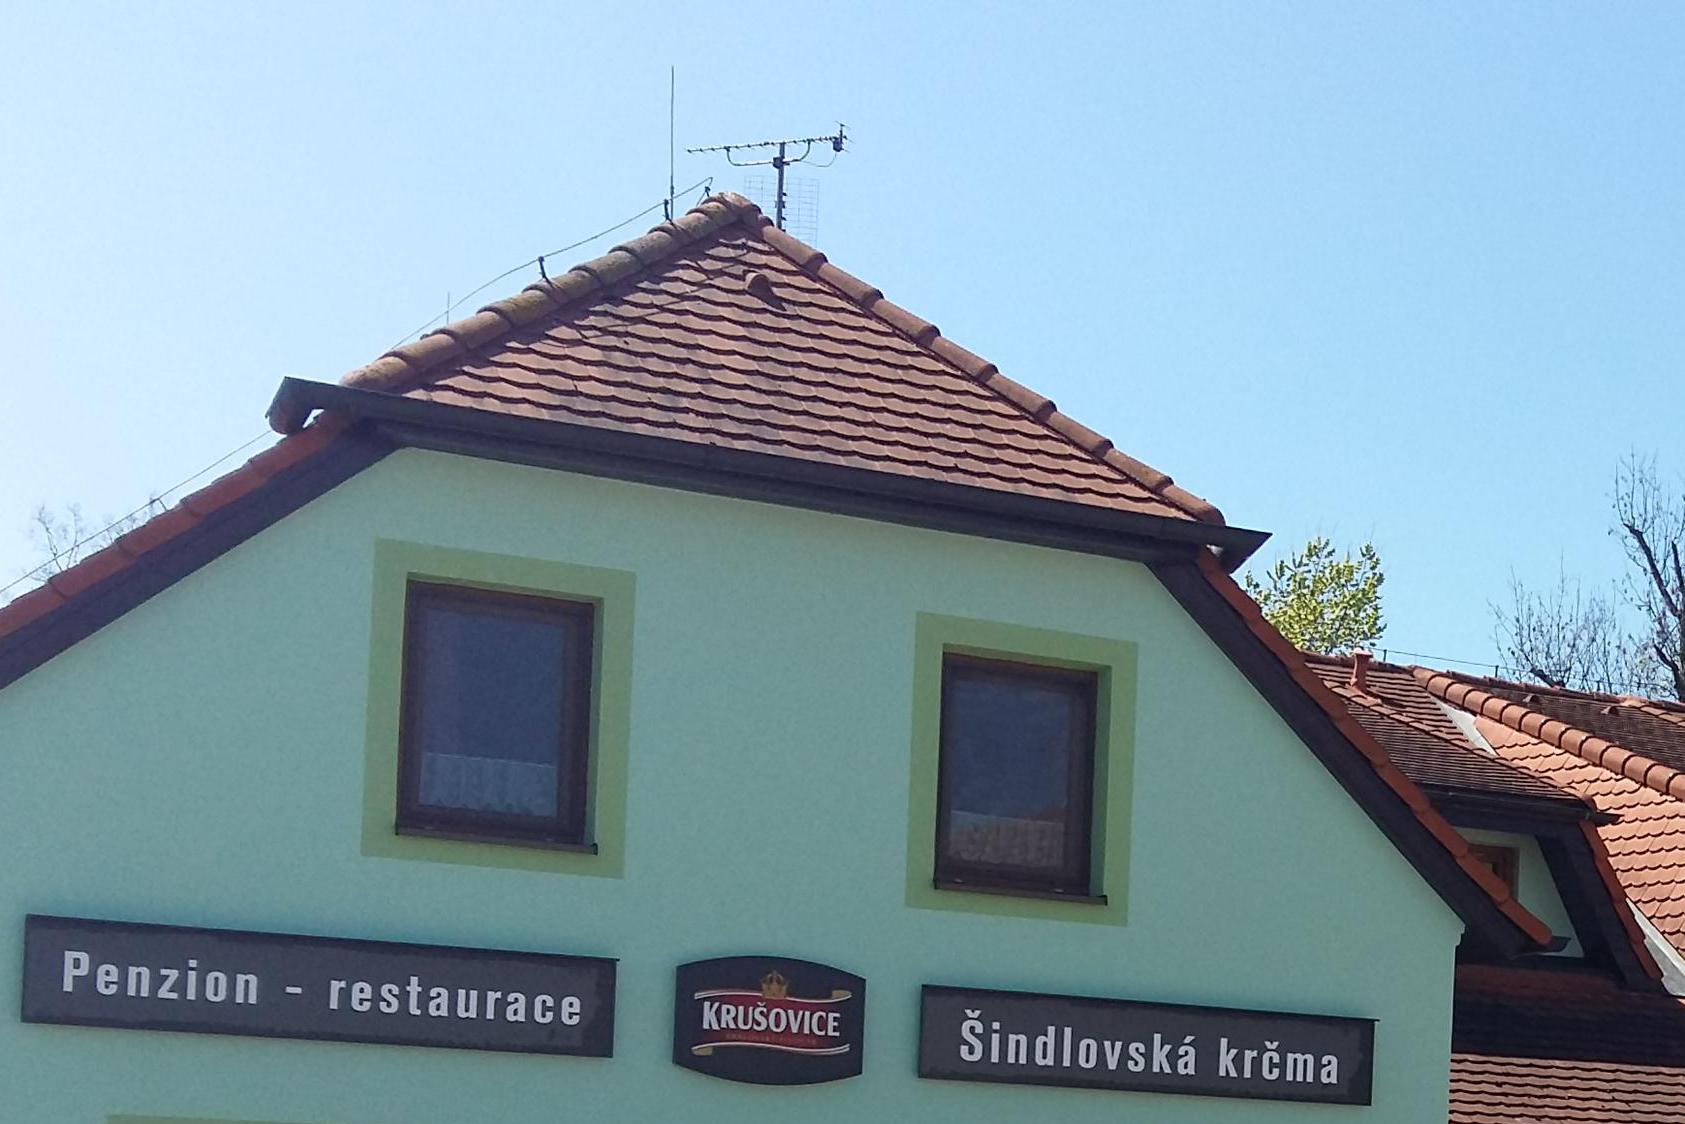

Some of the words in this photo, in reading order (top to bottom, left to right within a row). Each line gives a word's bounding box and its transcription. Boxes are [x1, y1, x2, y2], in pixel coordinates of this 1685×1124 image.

[63, 950, 258, 1005] Penzion
[329, 976, 581, 1025] restaurace
[702, 1001, 841, 1037] KRUŠOVICE
[960, 1009, 1196, 1075] Šindlovská
[1218, 1037, 1338, 1084] krčma
